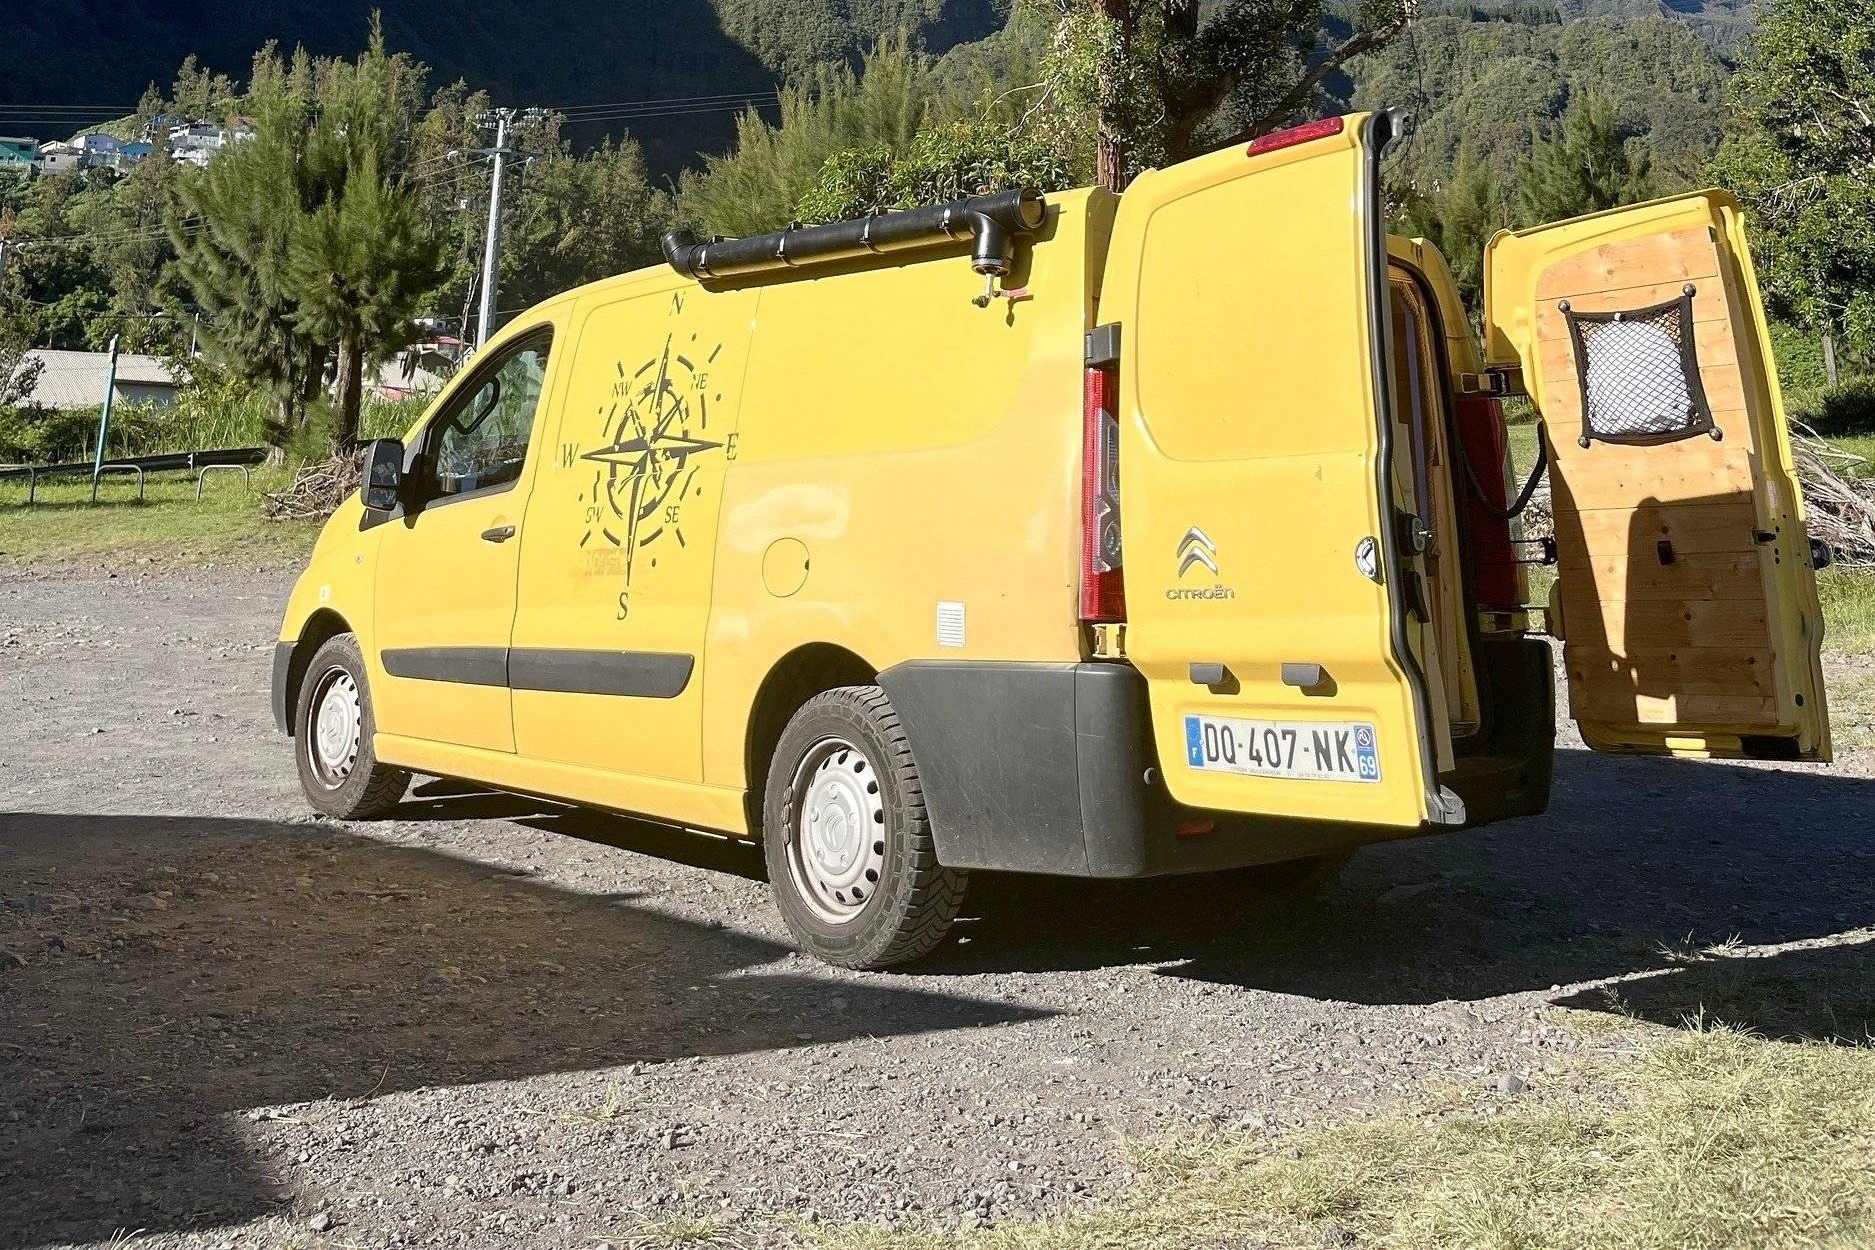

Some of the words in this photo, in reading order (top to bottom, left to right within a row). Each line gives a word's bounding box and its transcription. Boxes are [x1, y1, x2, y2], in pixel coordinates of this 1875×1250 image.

[670, 291, 686, 316] N
[612, 381, 633, 398] NW
[691, 373, 708, 390] NE
[563, 443, 580, 468] W
[726, 433, 739, 460] E
[665, 507, 680, 523] SE
[617, 592, 629, 621] S
[1360, 755, 1377, 776] 69
